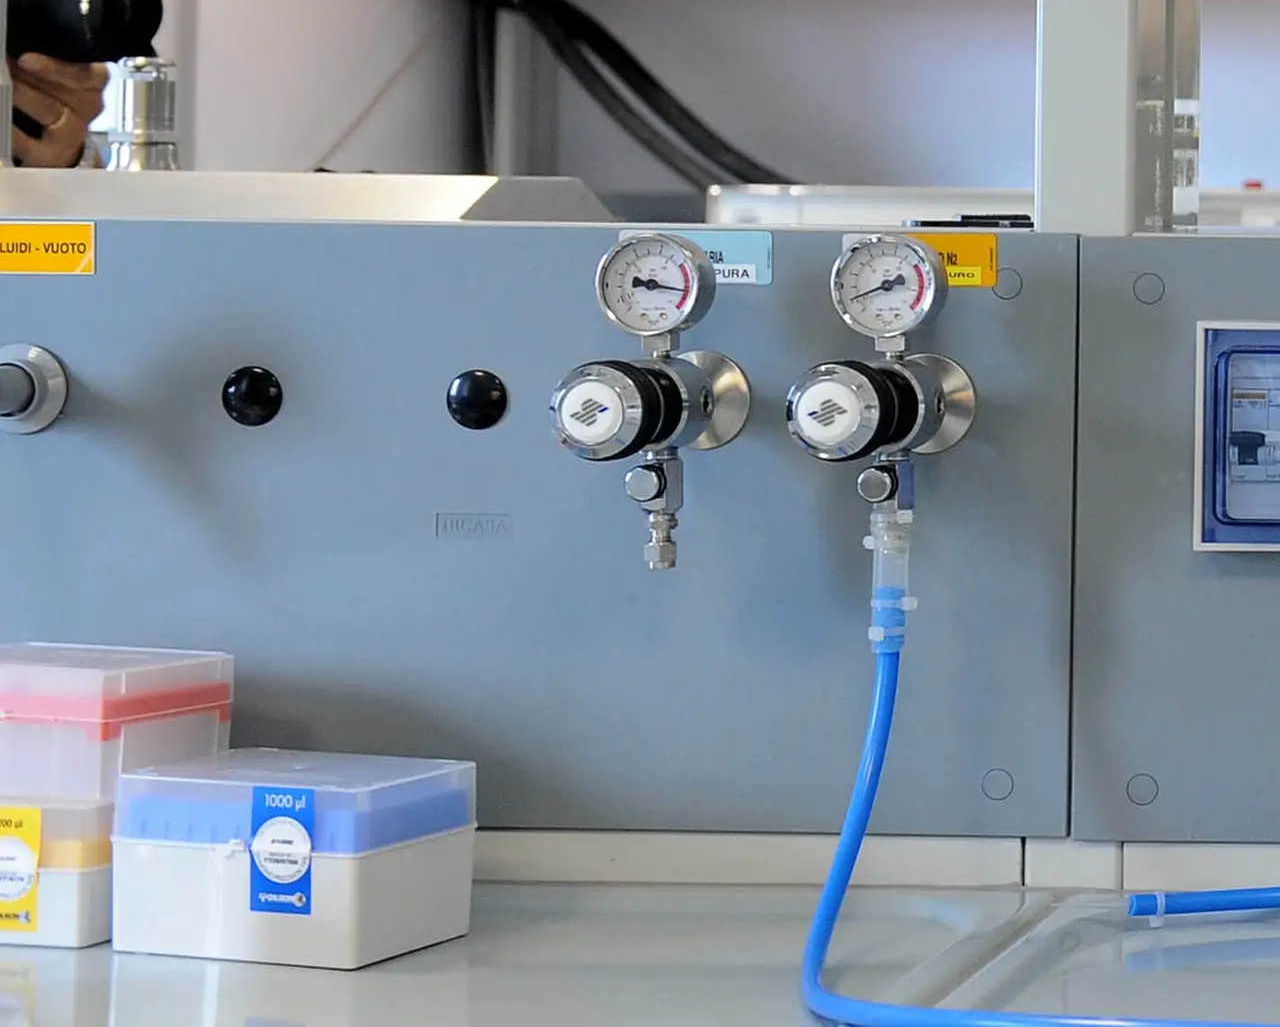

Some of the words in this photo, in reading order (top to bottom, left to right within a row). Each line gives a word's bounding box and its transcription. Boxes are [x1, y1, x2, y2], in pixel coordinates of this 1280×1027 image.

[0, 242, 31, 253] LUIDI
[43, 242, 87, 254] VUOTO
[705, 250, 724, 263] RIA
[714, 268, 750, 279] PURA
[265, 794, 293, 808] 1000
